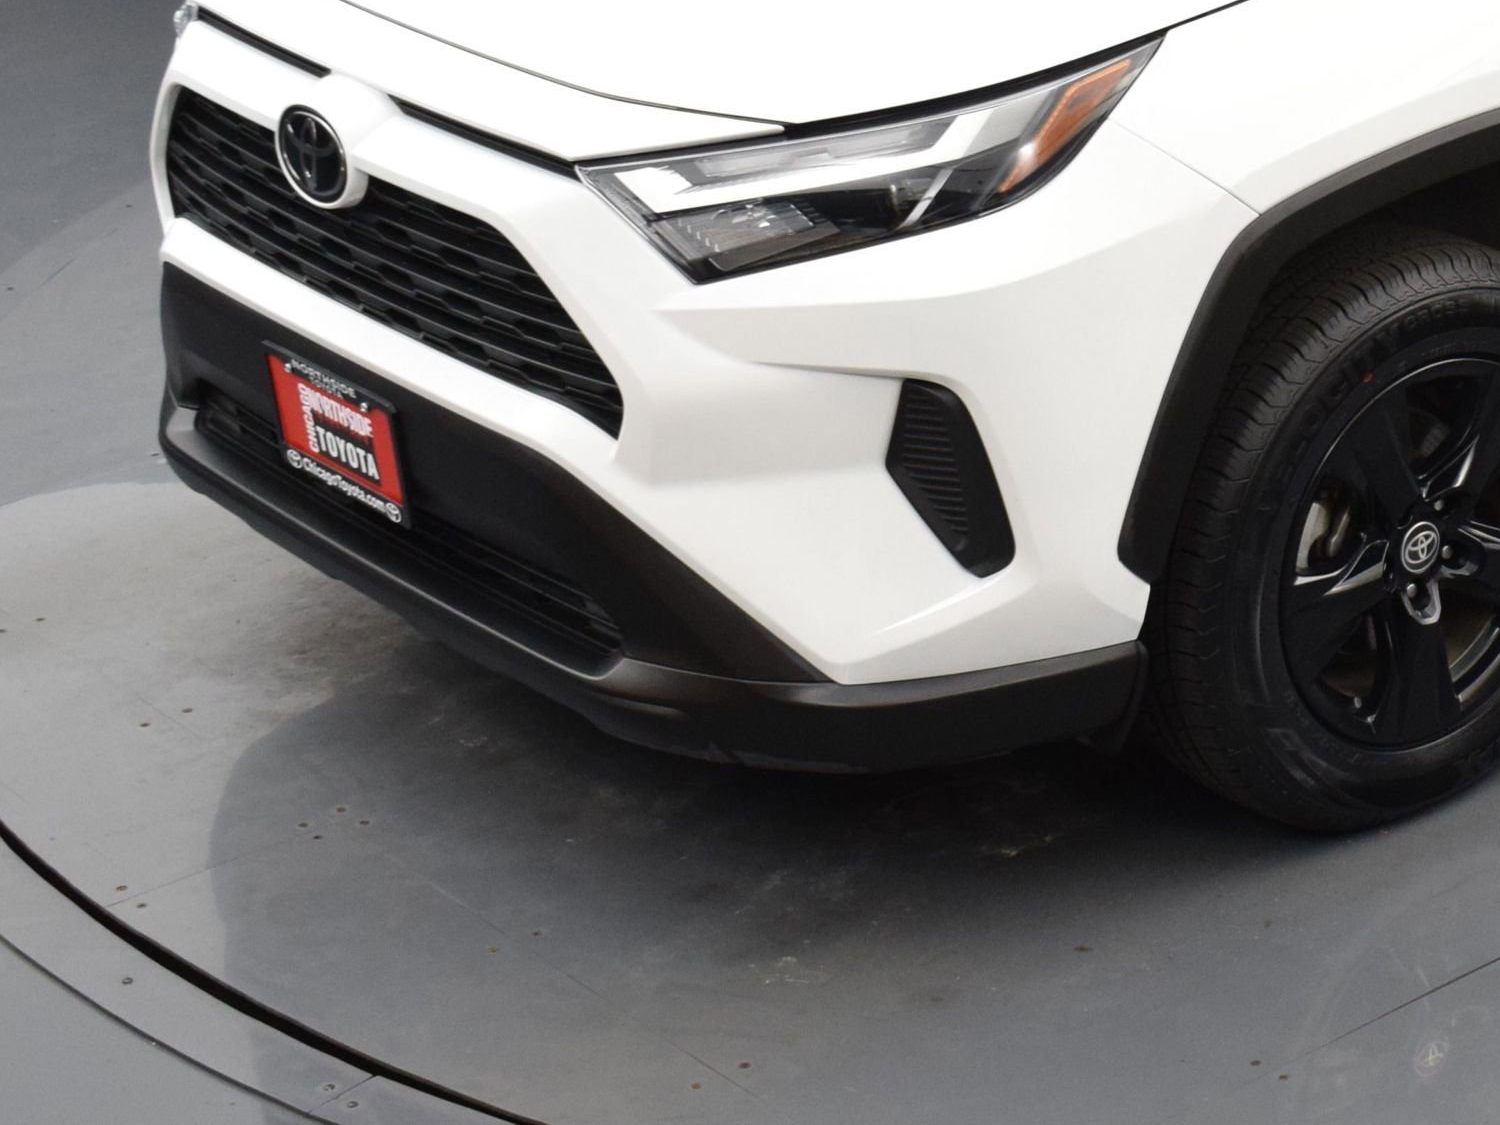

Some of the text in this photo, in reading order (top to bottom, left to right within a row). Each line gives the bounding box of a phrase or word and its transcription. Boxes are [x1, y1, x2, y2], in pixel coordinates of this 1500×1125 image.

[290, 358, 357, 399] NORTHSIDE
[297, 382, 320, 453] CHICAGO
[306, 389, 374, 438] NORTHSIDE
[314, 425, 380, 481] TOYOTA
